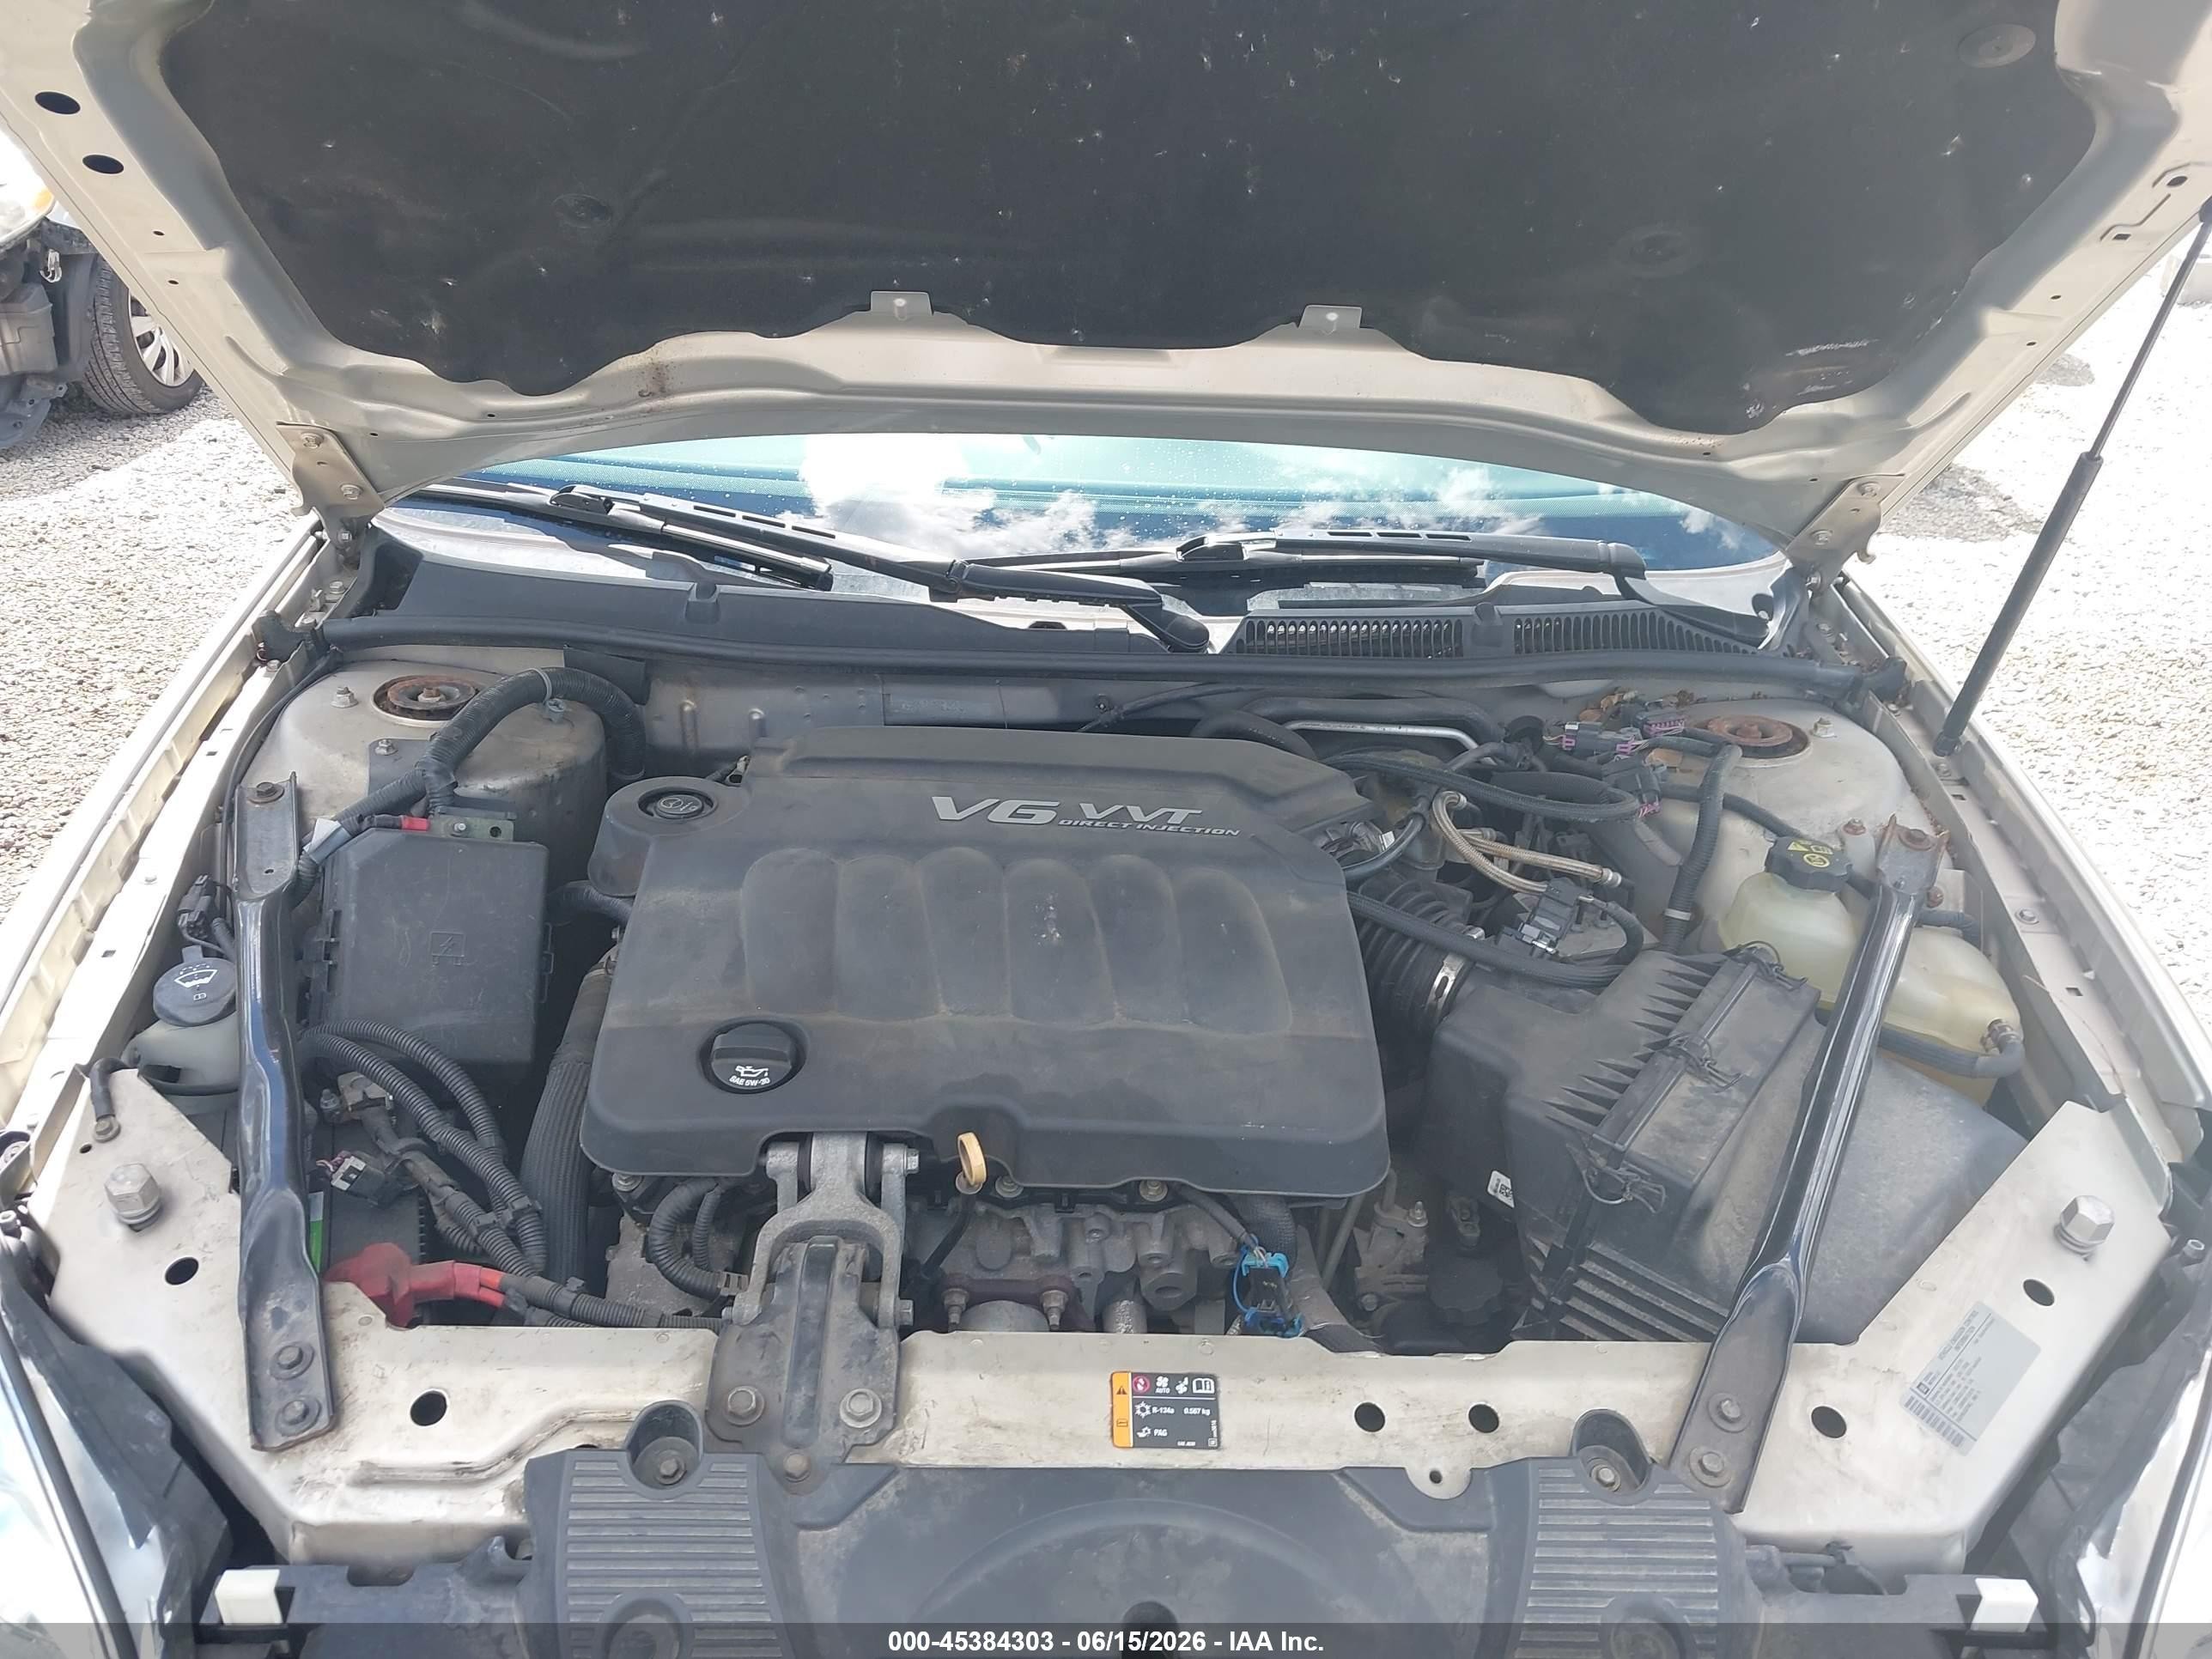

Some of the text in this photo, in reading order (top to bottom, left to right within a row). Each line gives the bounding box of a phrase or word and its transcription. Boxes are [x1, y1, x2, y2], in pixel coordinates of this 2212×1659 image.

[932, 796, 1203, 825] V6 VVT
[1058, 818, 1242, 836] DIRECT INJECTION
[1153, 1428, 1168, 1437] PAG
